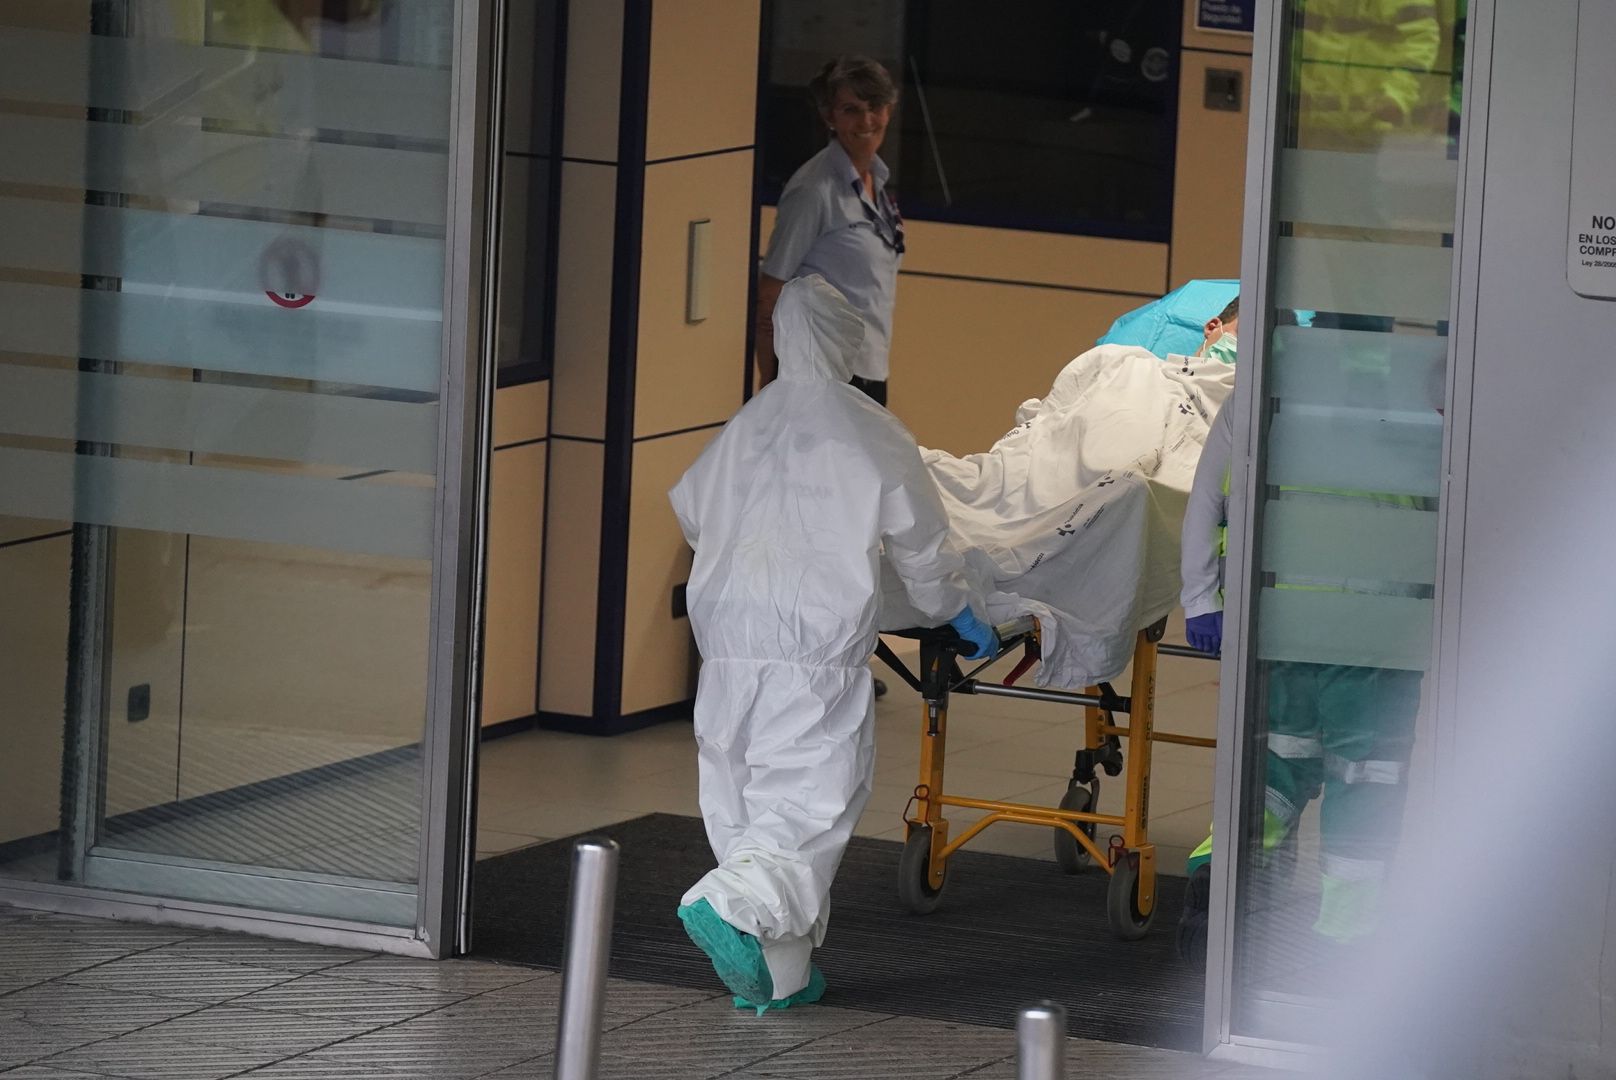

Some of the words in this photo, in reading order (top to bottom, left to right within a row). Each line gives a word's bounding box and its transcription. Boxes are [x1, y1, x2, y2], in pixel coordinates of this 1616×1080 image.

[1592, 215, 1616, 231] NO
[1578, 233, 1593, 244] EN
[1595, 234, 1616, 246] LOS
[1581, 259, 1593, 268] Ley
